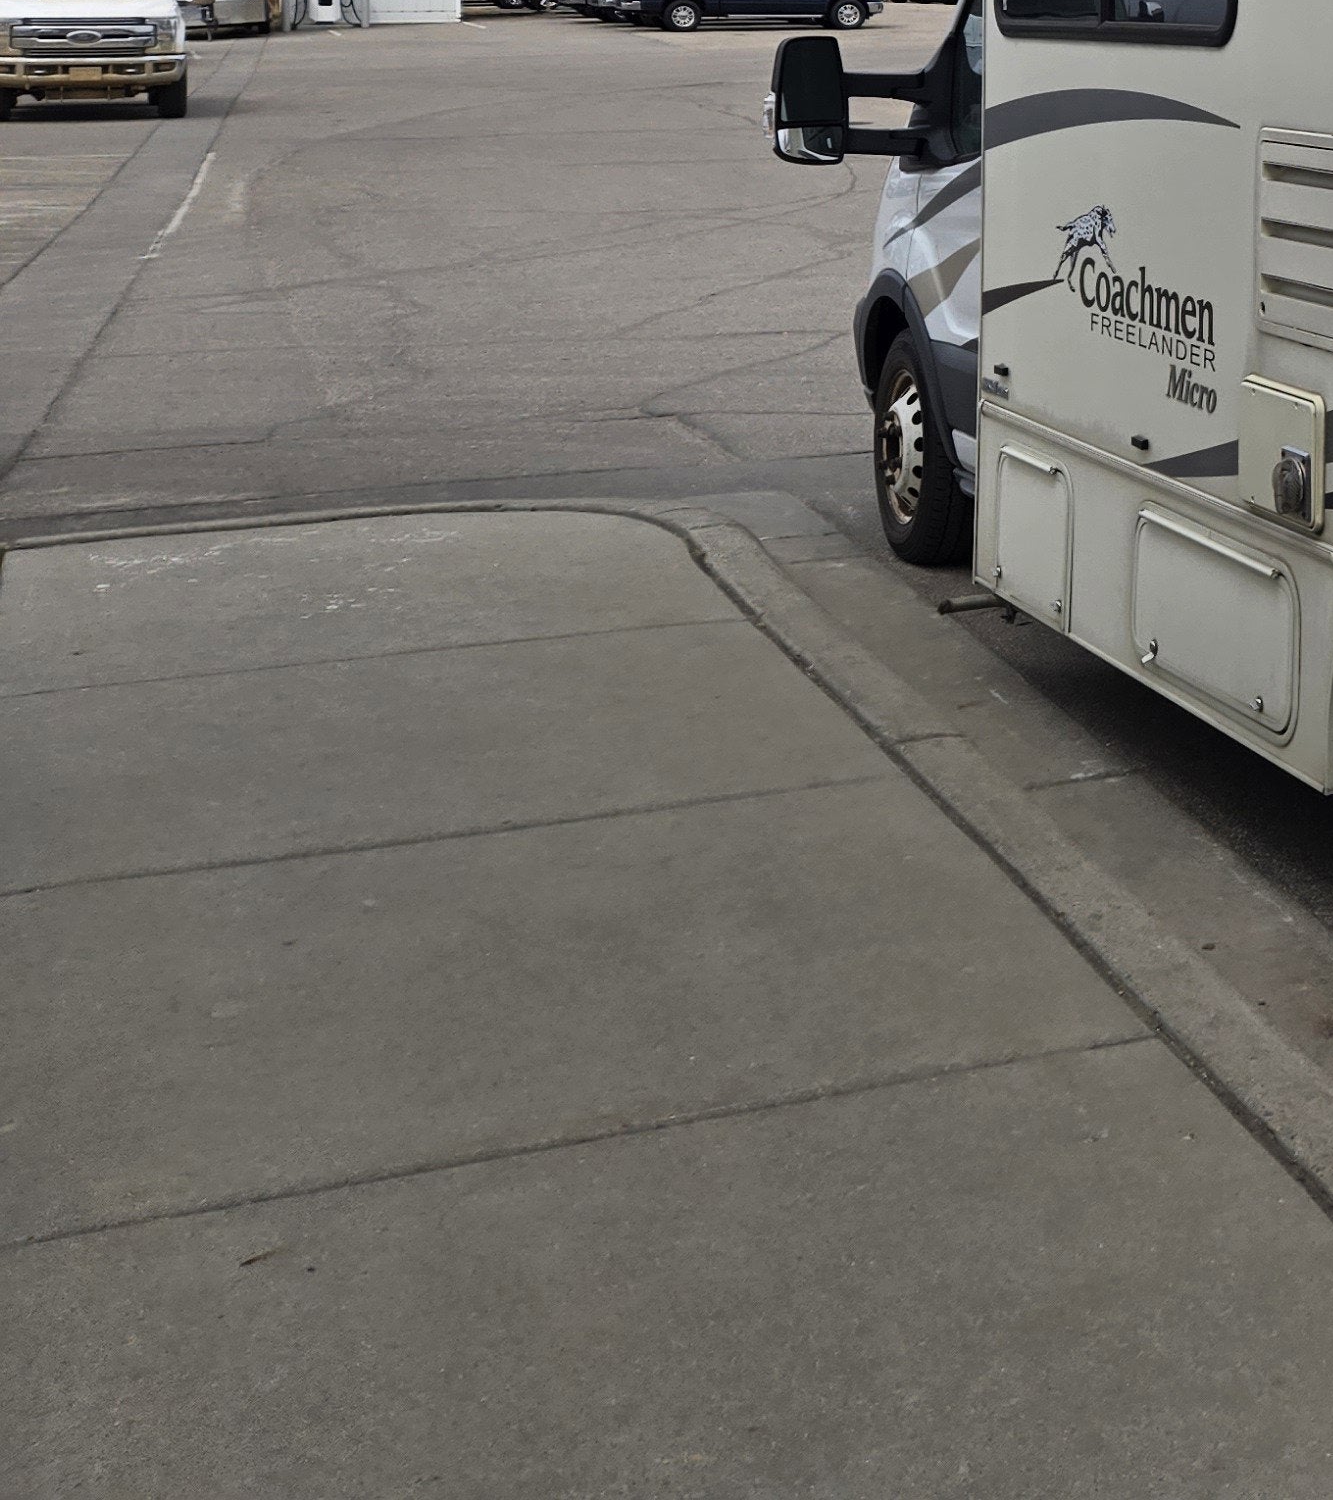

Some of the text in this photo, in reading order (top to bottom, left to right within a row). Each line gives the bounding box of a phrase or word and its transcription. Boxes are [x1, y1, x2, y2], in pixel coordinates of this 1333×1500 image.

[1079, 257, 1215, 347] Coachmen
[1090, 312, 1216, 373] FREELANDER
[1165, 364, 1218, 414] Micro
